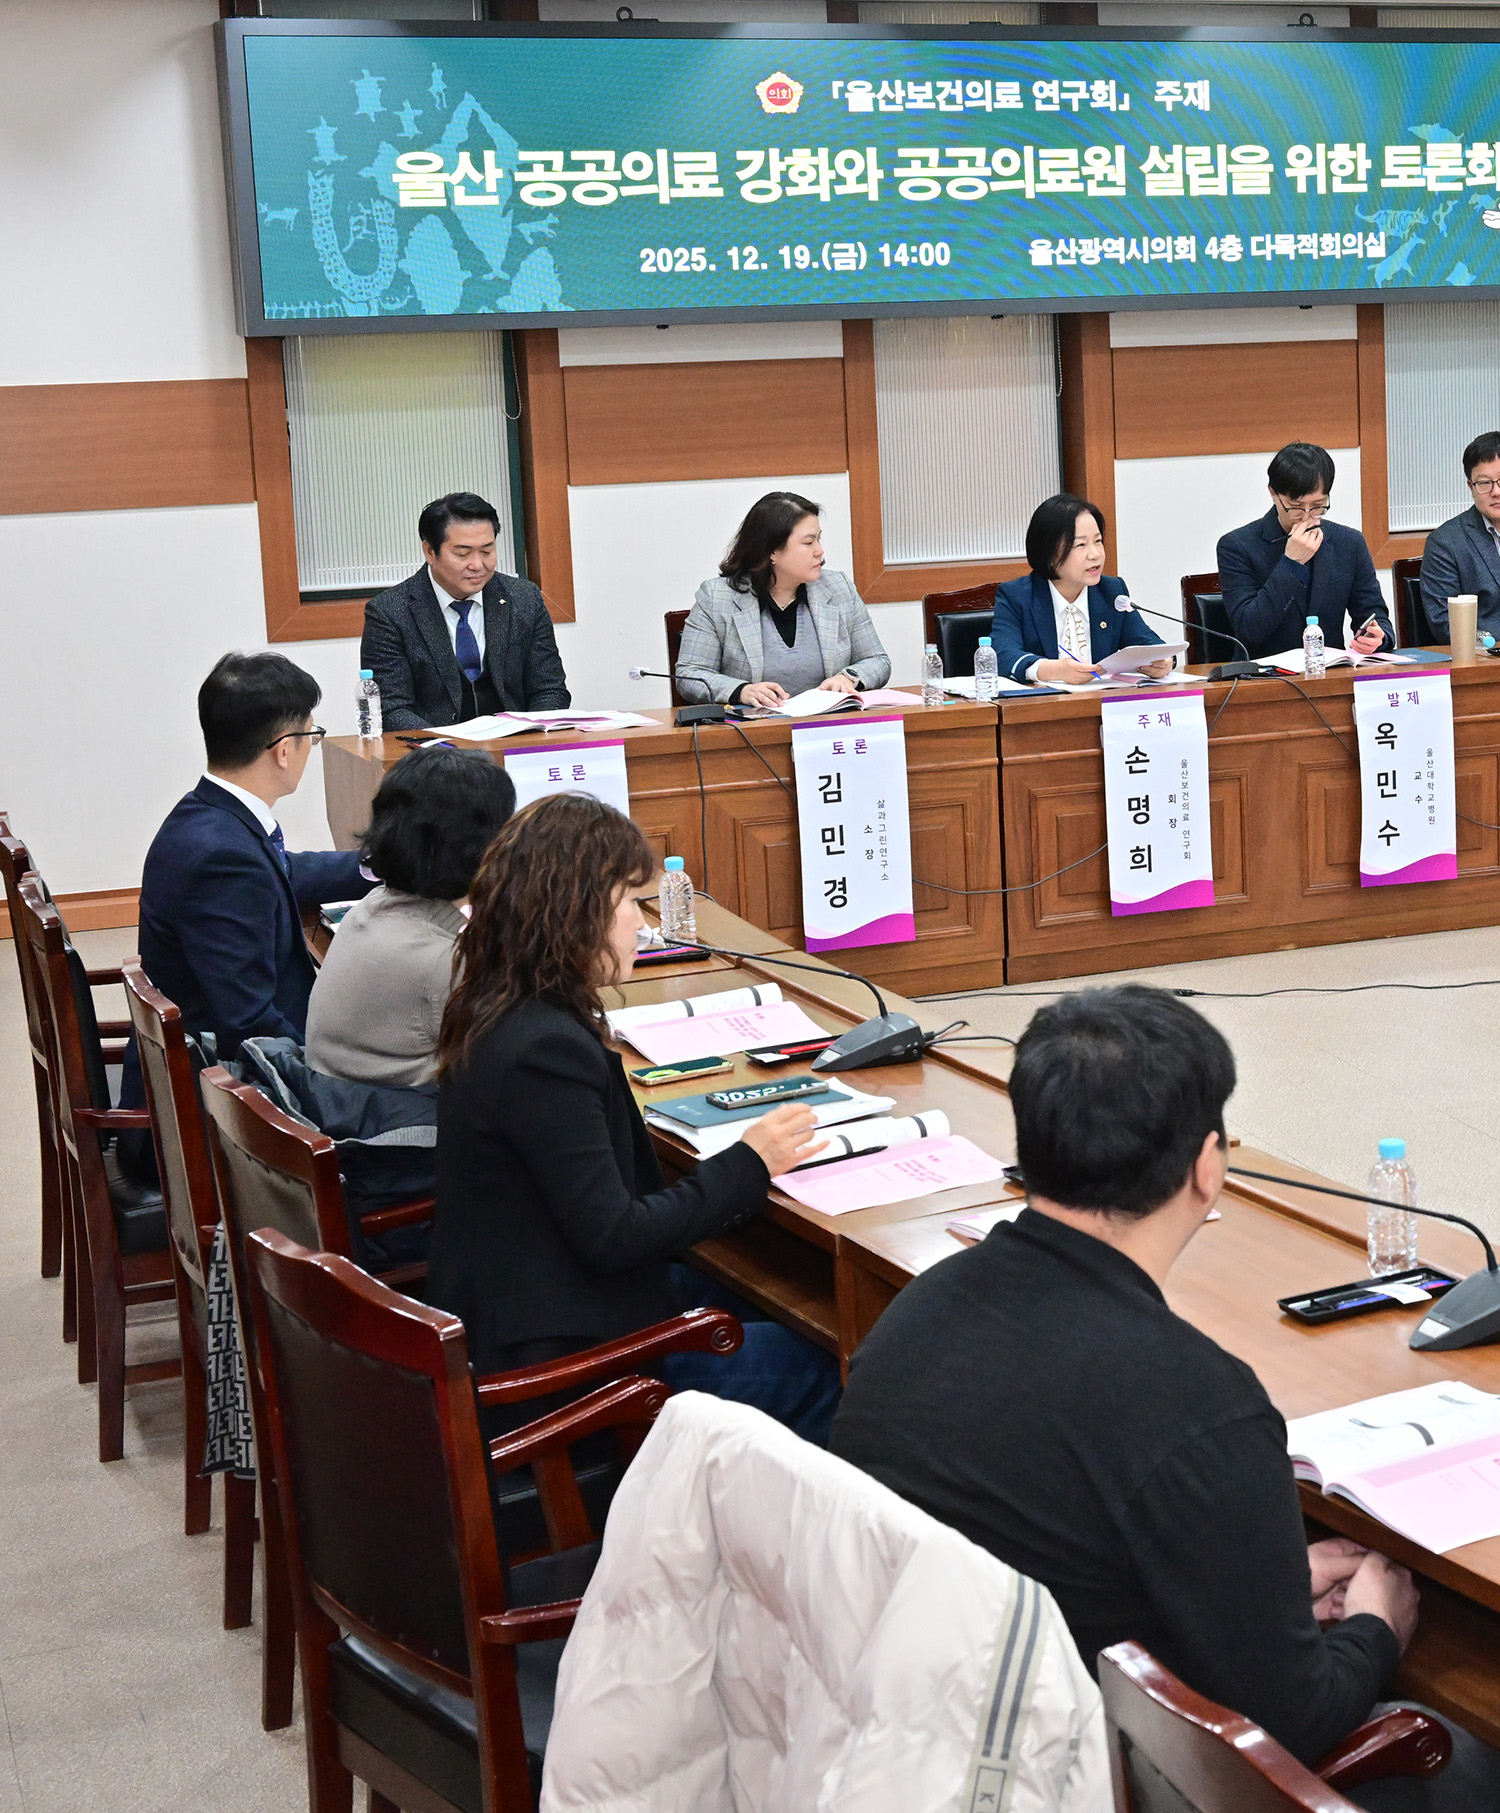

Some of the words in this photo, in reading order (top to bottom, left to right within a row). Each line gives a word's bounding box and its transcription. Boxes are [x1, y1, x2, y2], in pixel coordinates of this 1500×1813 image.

[767, 87, 793, 101] 의회
[832, 79, 1023, 113] 「울산보건의료
[1032, 79, 1130, 112] 연구회」
[1154, 79, 1211, 112] 주재
[391, 150, 504, 208] 울산
[514, 148, 724, 207] 공공의료
[735, 146, 885, 204] 강화와
[893, 144, 1126, 201] 공공의료원
[1138, 143, 1274, 197] 설립을
[1284, 142, 1372, 195] 위한
[639, 247, 716, 273] 2025.
[727, 245, 768, 271] 12.
[778, 241, 868, 271] 19.(금)
[878, 242, 951, 267] 14:00
[1028, 235, 1197, 266] 울산광역시의회
[1204, 234, 1244, 262] 4층
[1250, 231, 1387, 261] 다목적회의실
[1387, 690, 1421, 708] 발제
[1137, 711, 1172, 729] 주재
[831, 738, 869, 756] 토론
[547, 764, 587, 782] 토론
[1180, 758, 1190, 823] 울산보건의료
[1374, 722, 1401, 847] 옥민수
[1413, 771, 1424, 805] 교수
[1425, 747, 1436, 825] 울산대학교병원
[1124, 745, 1153, 874] 손명희
[1167, 793, 1178, 829] 회장
[817, 772, 849, 910] 김민경
[863, 824, 875, 861] 소장
[876, 798, 890, 882] 삶과그린연구소
[1182, 829, 1192, 861] 연구회
